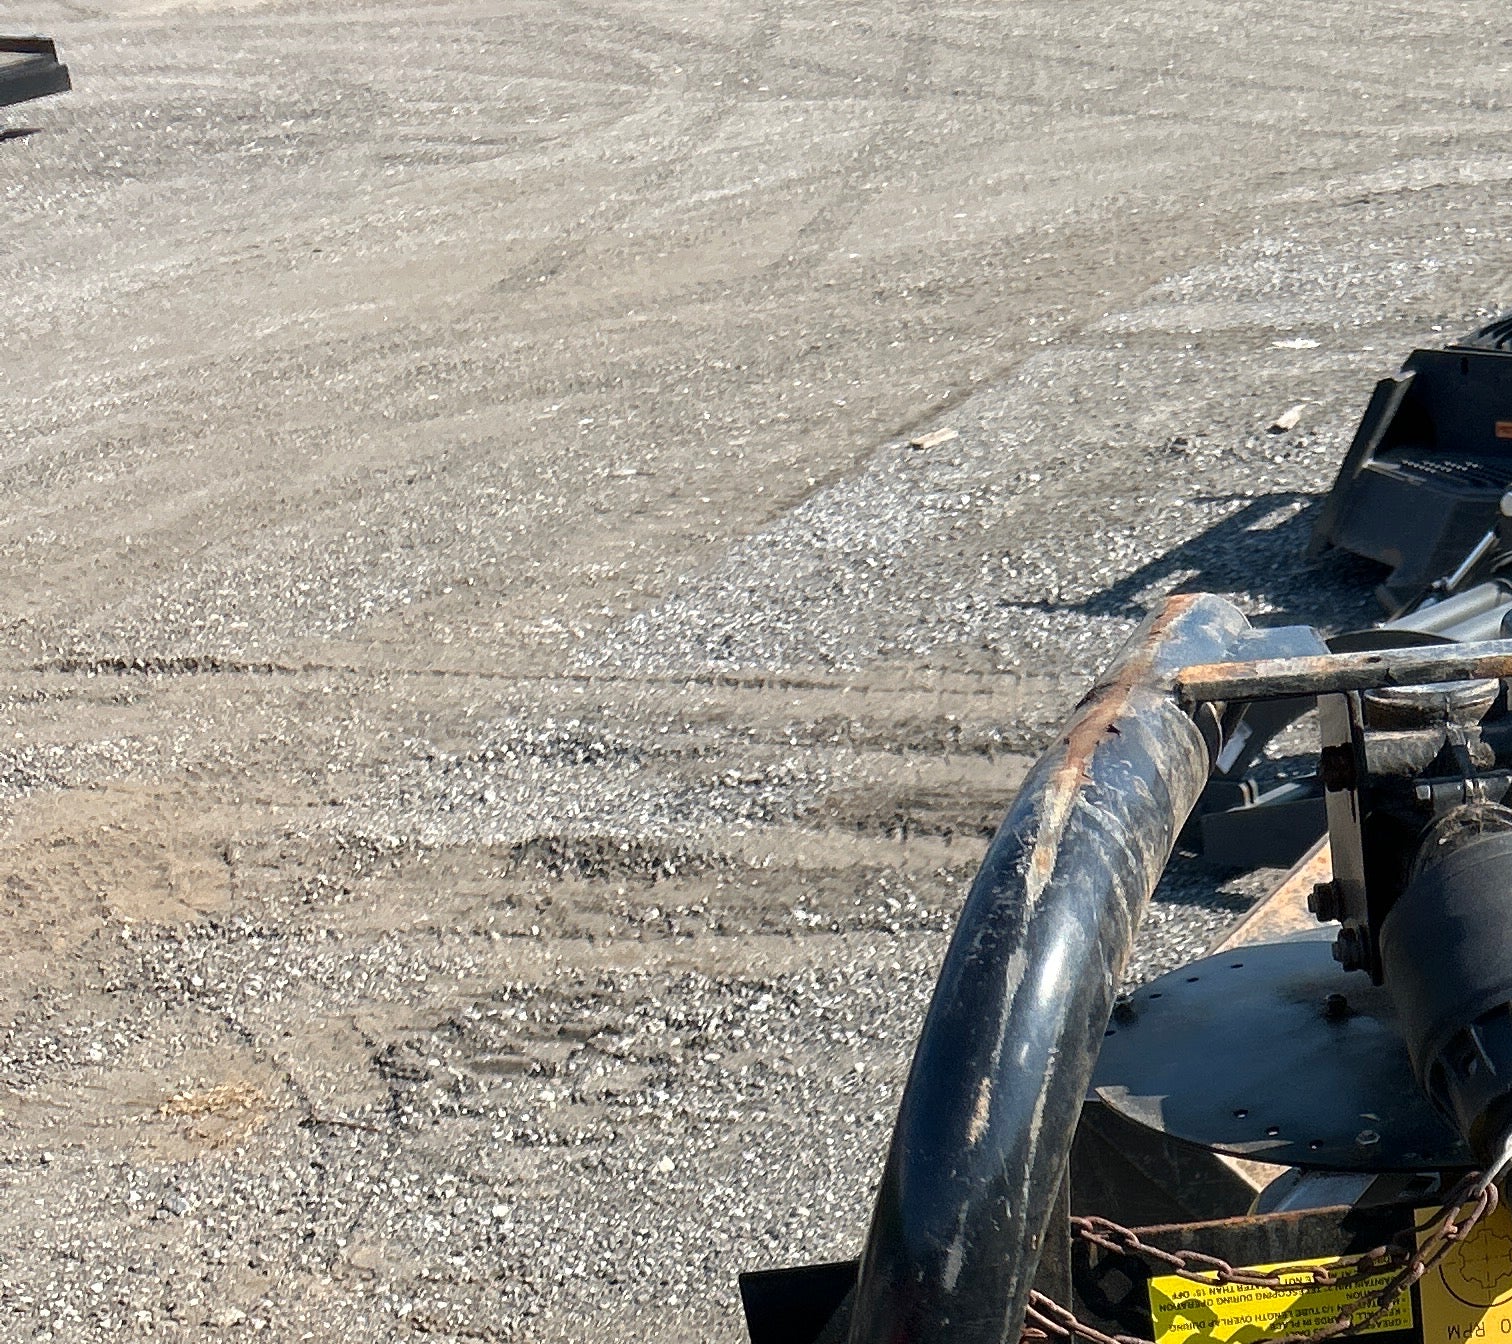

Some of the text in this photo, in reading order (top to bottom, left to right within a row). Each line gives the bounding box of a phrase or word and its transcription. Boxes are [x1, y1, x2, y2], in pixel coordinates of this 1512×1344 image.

[1172, 1291, 1189, 1299] OFF
[1209, 1286, 1234, 1295] THAN
[1216, 1294, 1252, 1305] DURING
[1159, 1299, 1213, 1312] OPERATION
[1208, 1316, 1252, 1327] OVERLAP
[1448, 1322, 1485, 1340] RPM
